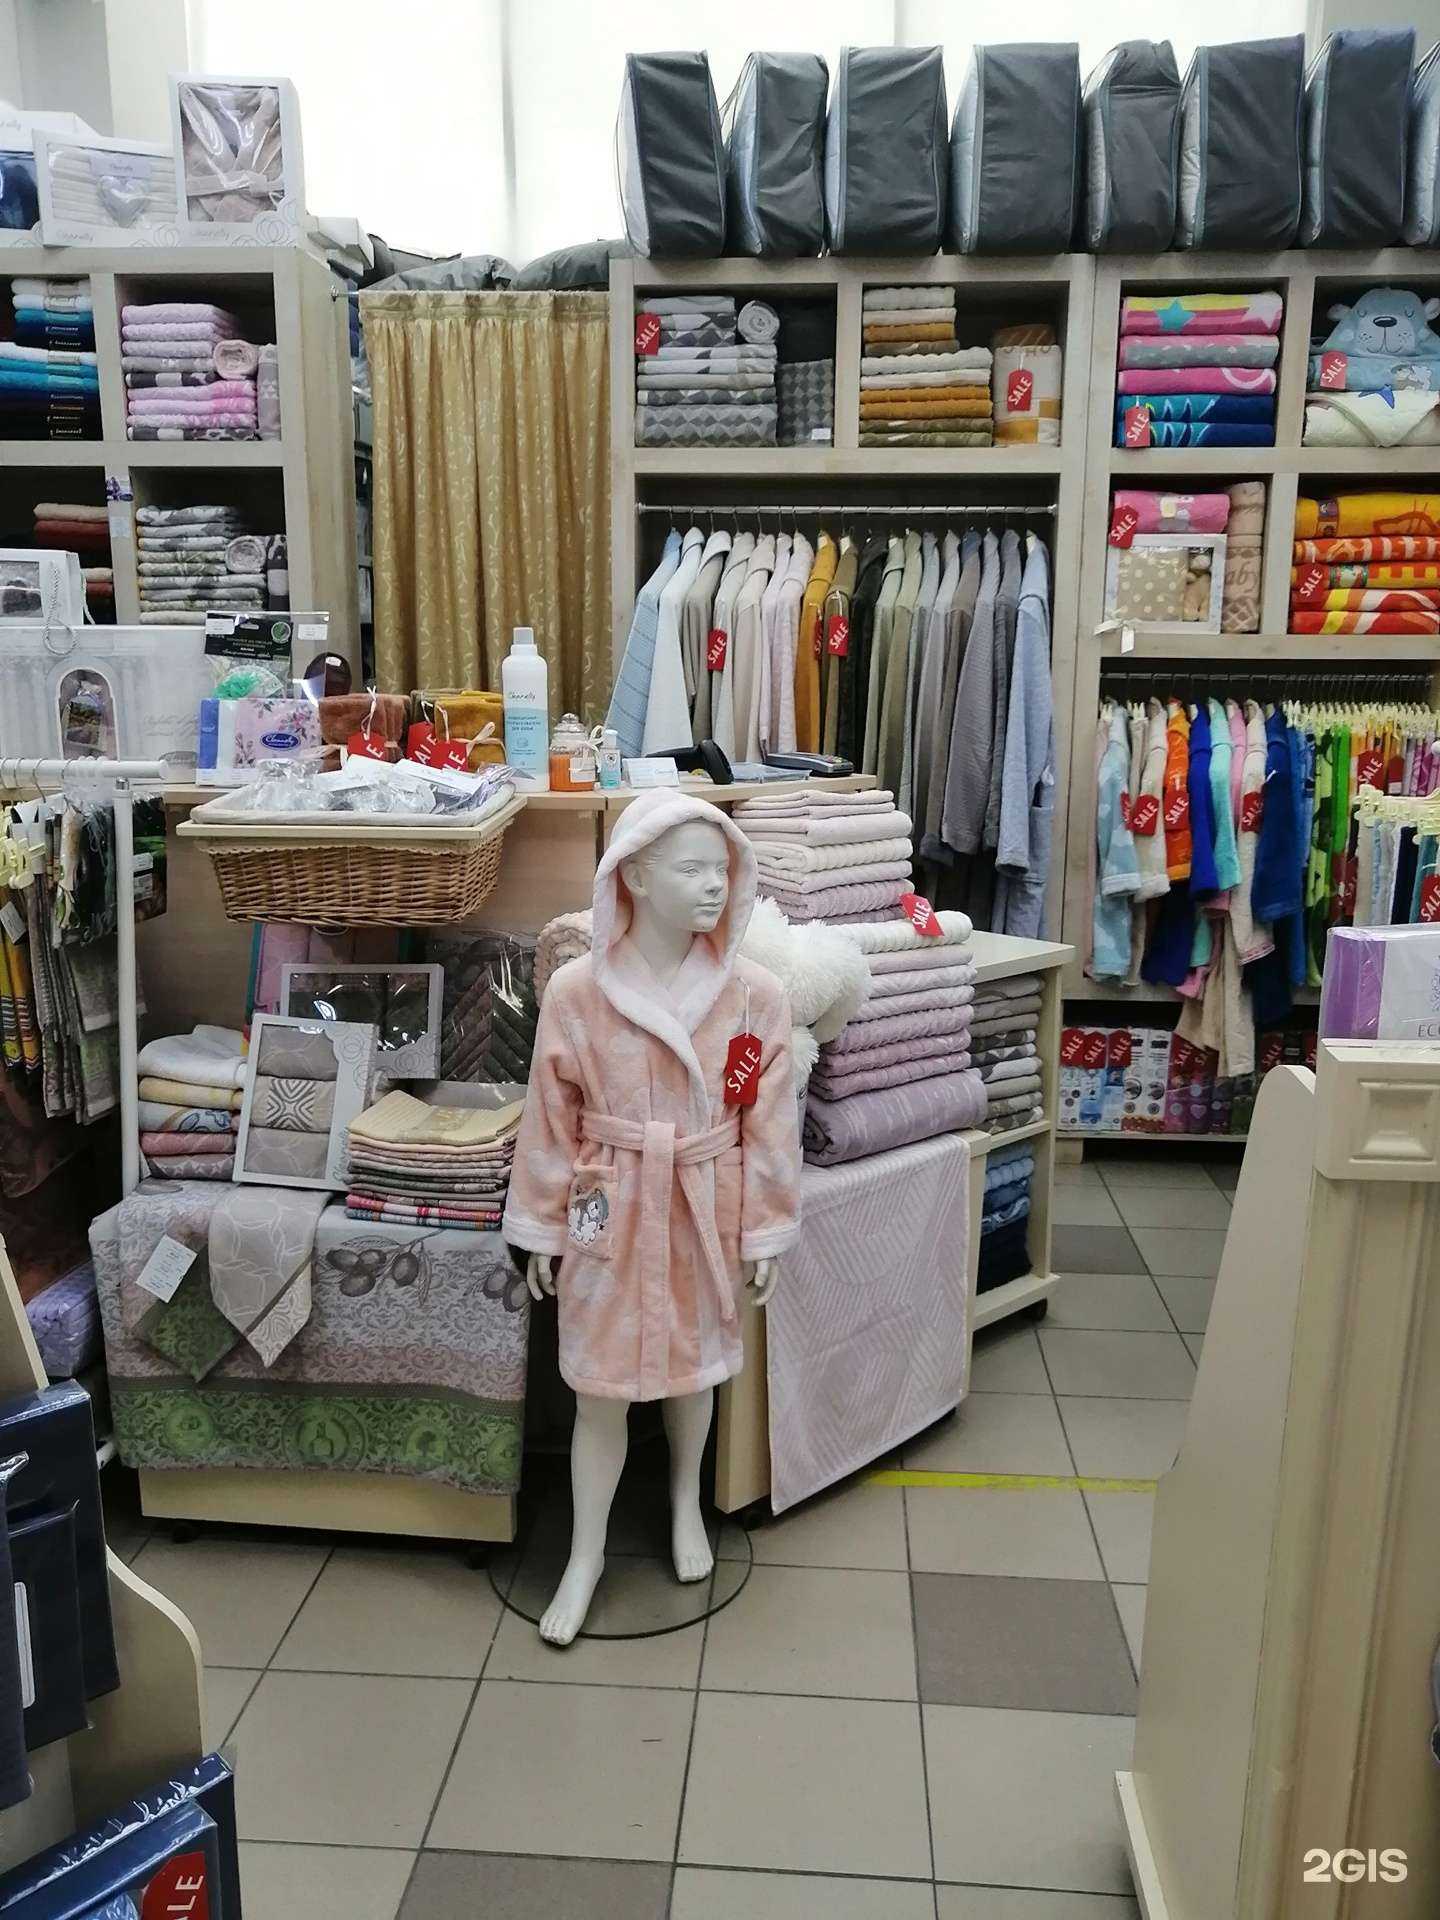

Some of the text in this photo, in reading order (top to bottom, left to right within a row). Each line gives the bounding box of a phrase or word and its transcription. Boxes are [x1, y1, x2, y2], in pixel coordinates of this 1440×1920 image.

[636, 321, 660, 349] SALE
[1322, 358, 1347, 384] SALE
[1008, 377, 1032, 405] SALE
[1126, 413, 1150, 442] SALE
[1111, 514, 1137, 542] SALE
[1300, 570, 1323, 597] SALE
[829, 623, 849, 650] SALE
[708, 637, 727, 664] SALE
[1358, 758, 1384, 785] SALE
[1133, 802, 1158, 829] SALE
[1165, 797, 1189, 825] SALE
[1242, 800, 1264, 826] SALE
[912, 902, 930, 929] SALE
[1418, 1022, 1440, 1038] EC
[1062, 1035, 1084, 1060] SALE
[1084, 1039, 1107, 1063] SALE
[1110, 1038, 1131, 1062] SALE
[1262, 1042, 1282, 1067] SALE
[727, 1048, 761, 1094] SALE
